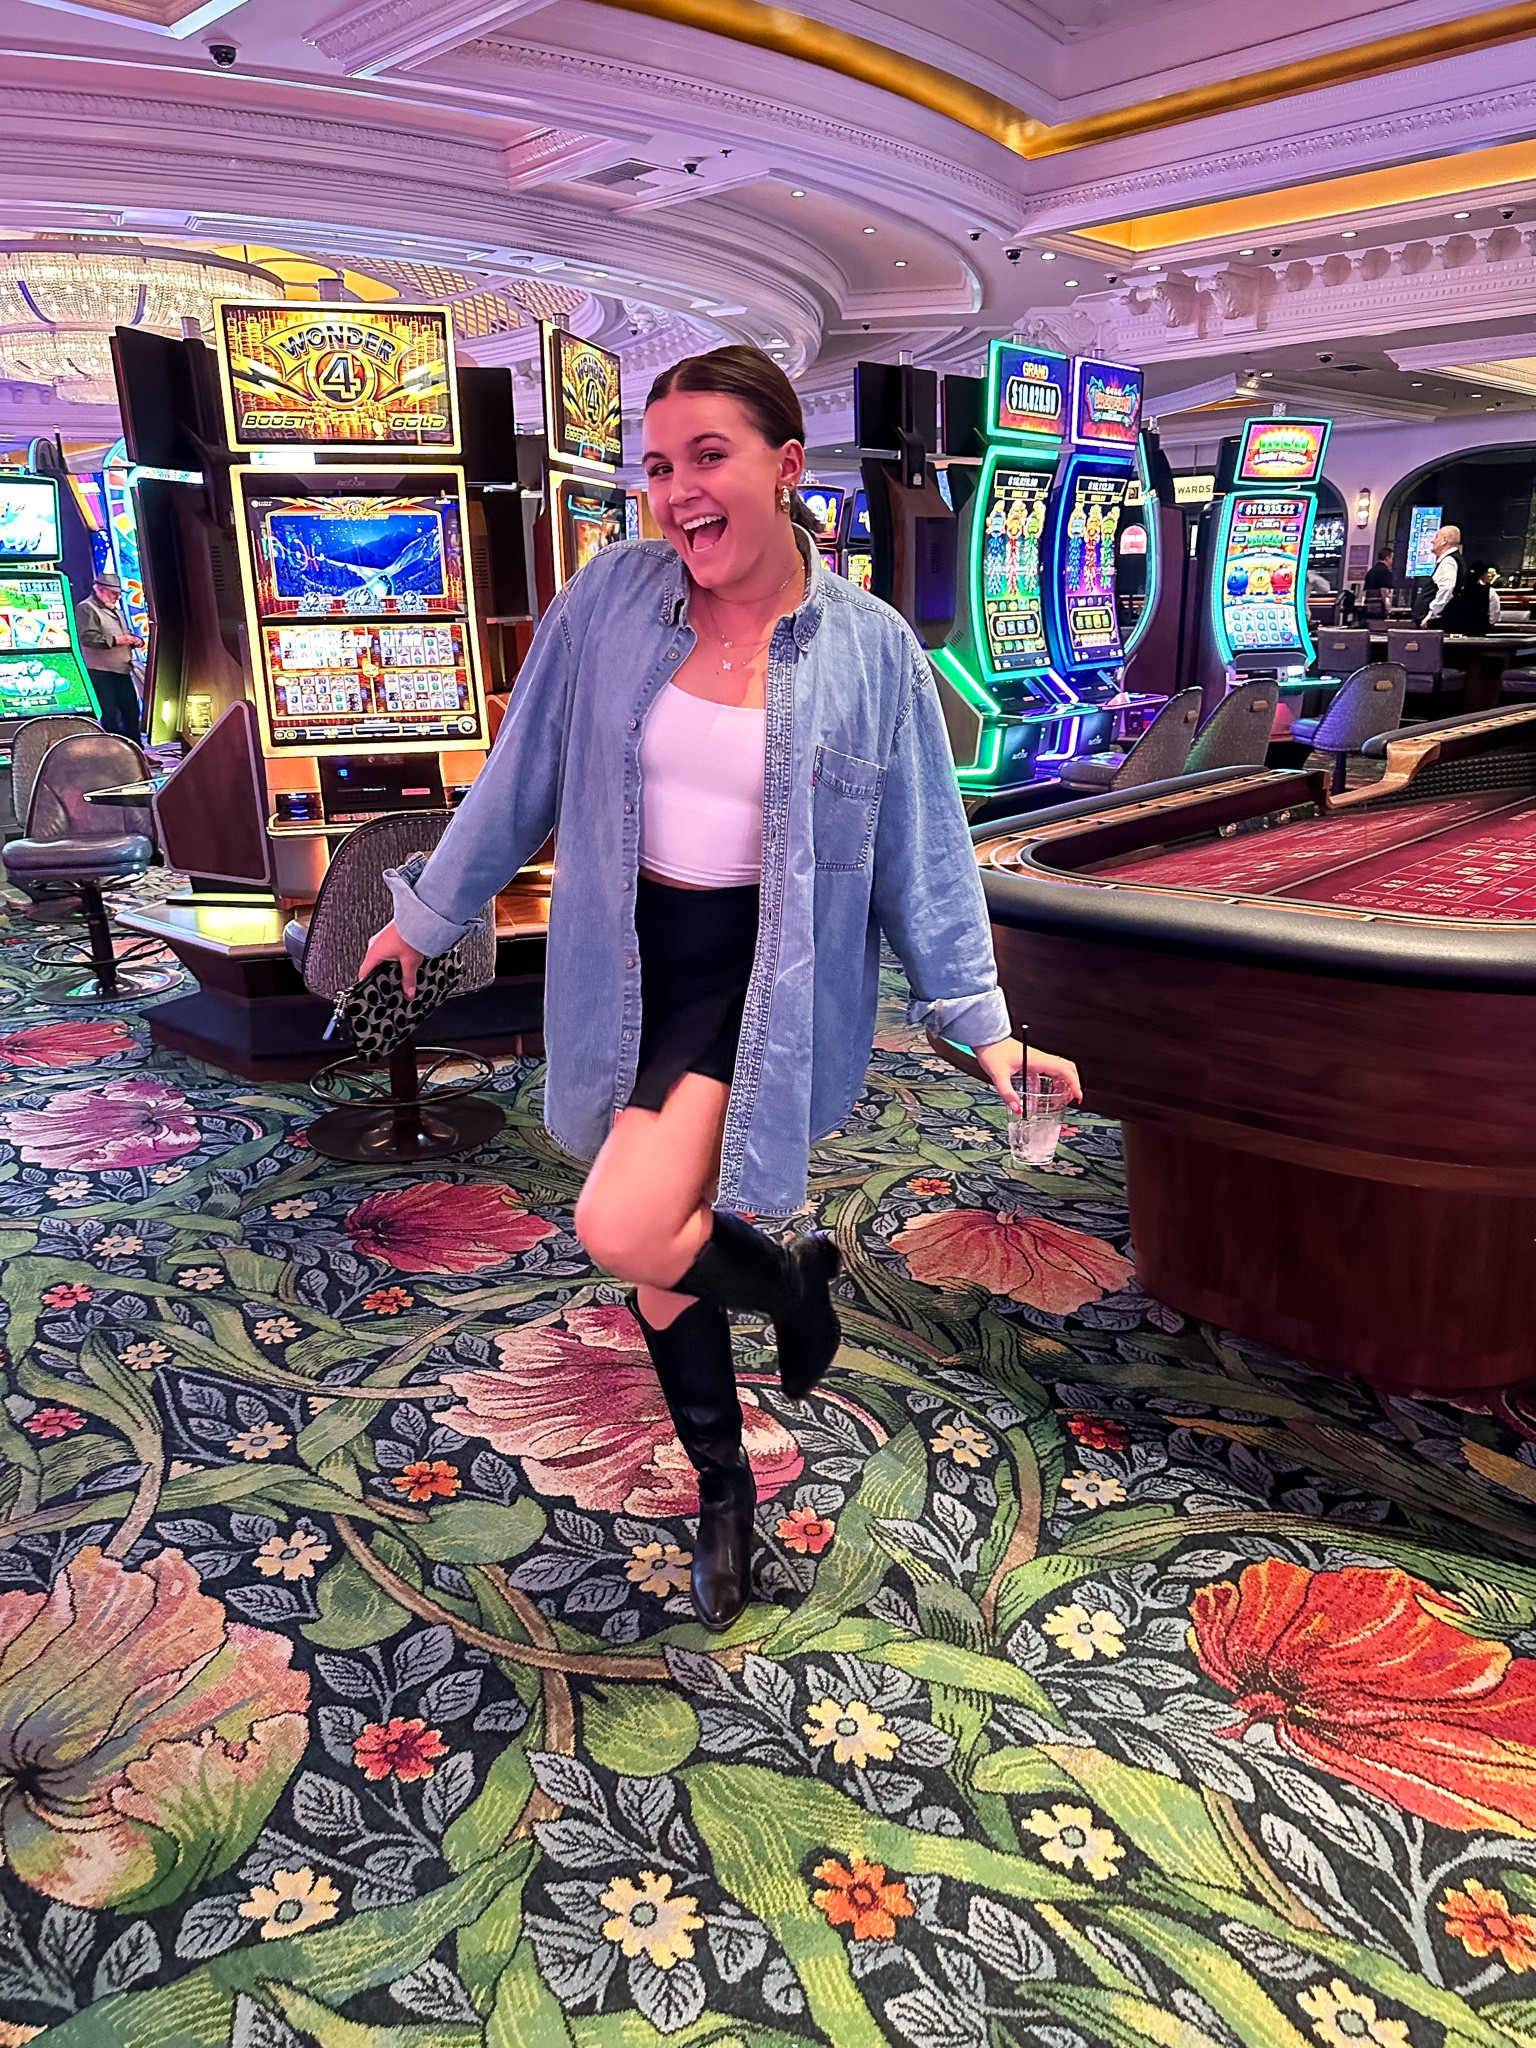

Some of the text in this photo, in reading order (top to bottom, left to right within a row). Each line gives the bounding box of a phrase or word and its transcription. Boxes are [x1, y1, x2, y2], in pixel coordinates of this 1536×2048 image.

[279, 325, 397, 364] WONDER
[320, 352, 361, 399] 4
[575, 356, 607, 388] WONDER
[1023, 361, 1049, 380] GRAND
[587, 380, 599, 421] 4
[244, 414, 445, 429] BOOST GOLD
[1177, 485, 1211, 494] WARDS
